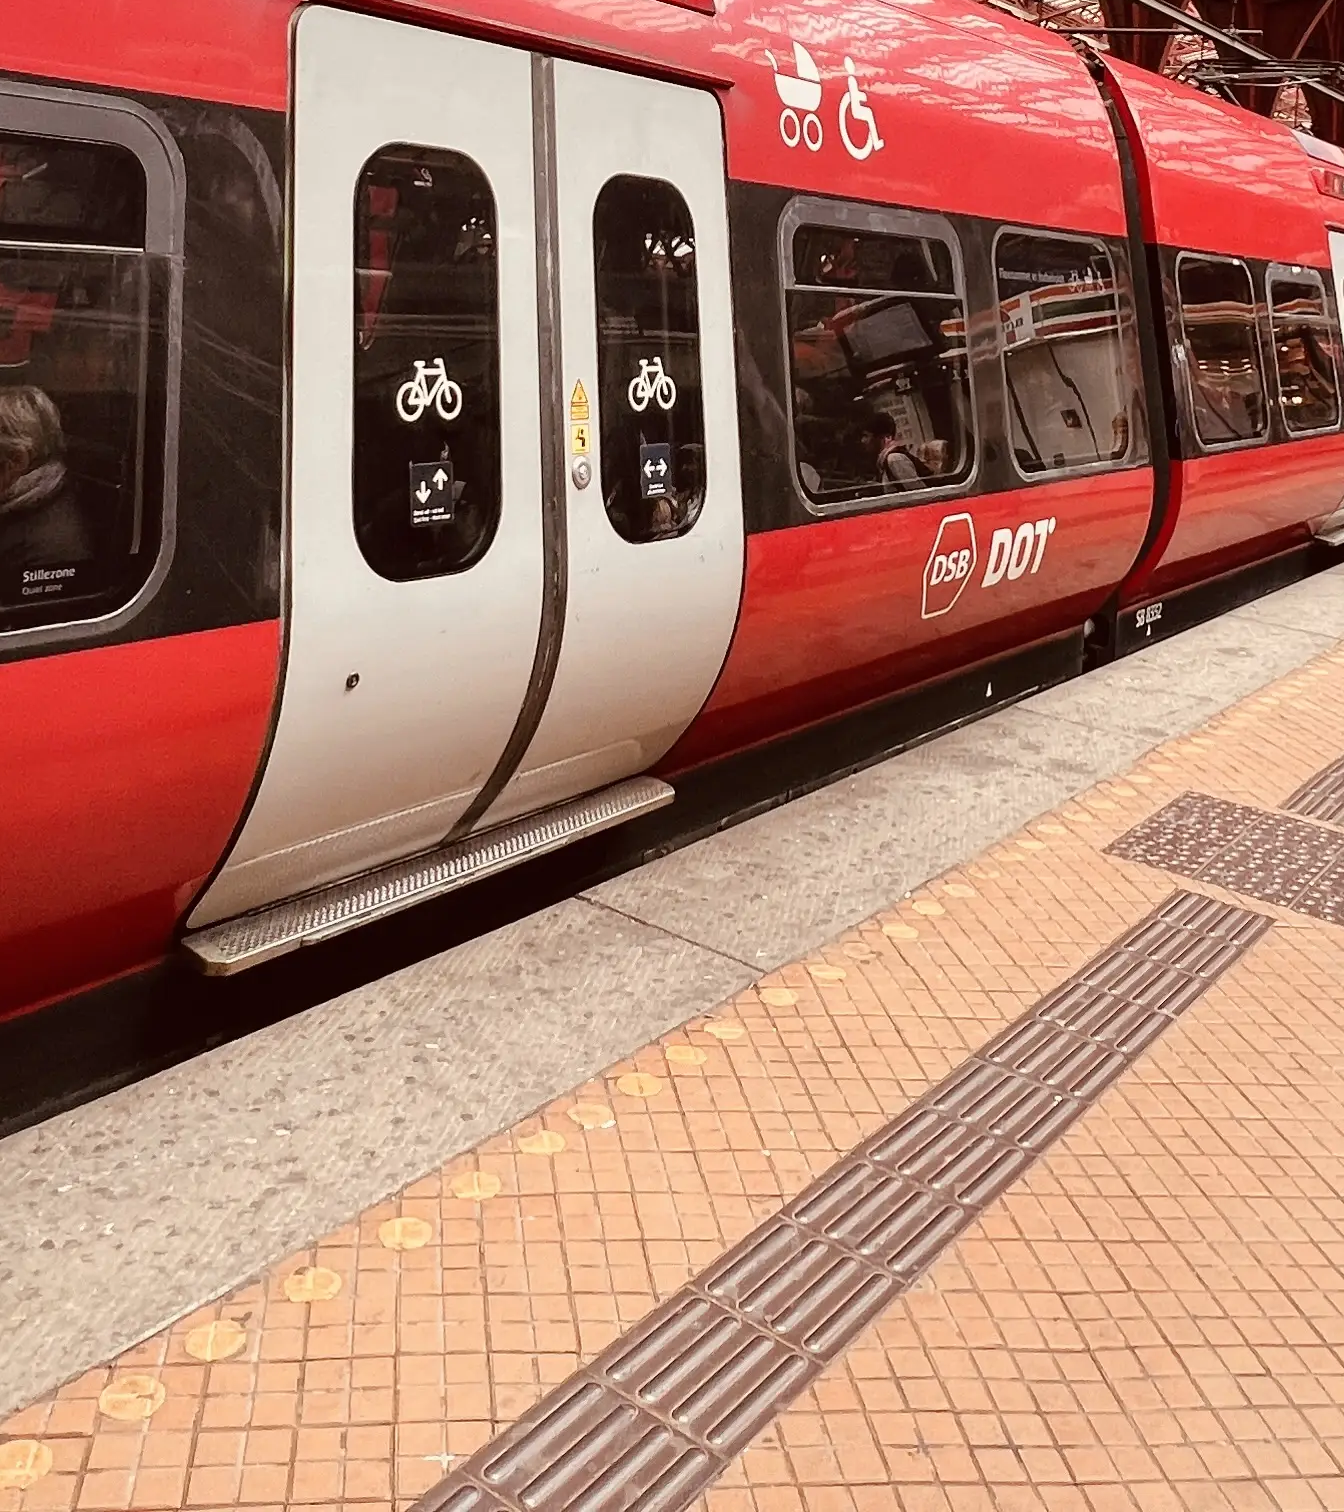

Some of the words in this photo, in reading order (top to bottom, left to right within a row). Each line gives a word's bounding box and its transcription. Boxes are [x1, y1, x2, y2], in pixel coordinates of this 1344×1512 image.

[929, 548, 971, 586] DSB
[981, 516, 1056, 589] DOT
[22, 568, 76, 583] Stillezone
